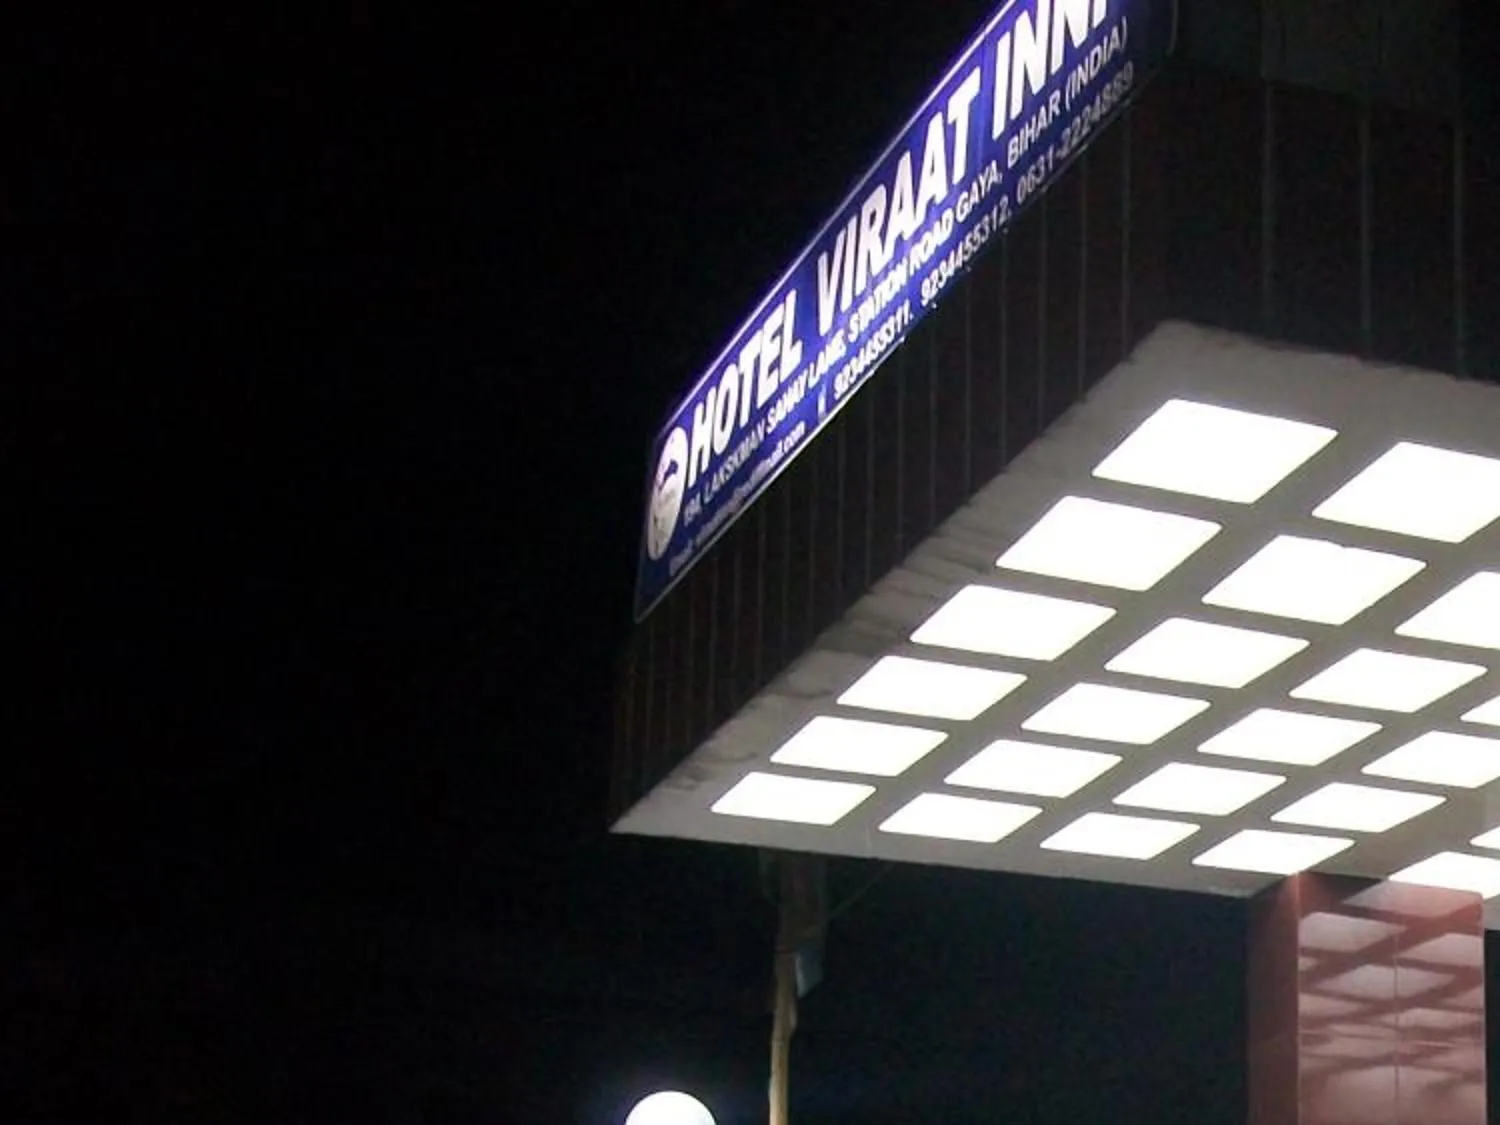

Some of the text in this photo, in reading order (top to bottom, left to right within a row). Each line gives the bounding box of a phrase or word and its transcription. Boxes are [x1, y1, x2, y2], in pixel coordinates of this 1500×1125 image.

[688, 289, 802, 488] HOTEL
[818, 66, 981, 336] VIRAAT
[848, 256, 907, 342] STATION
[909, 208, 954, 275] ROAD
[956, 160, 1002, 223] GAYA,
[1008, 89, 1060, 169] BIHAR
[1065, 16, 1128, 112] (INDIA)
